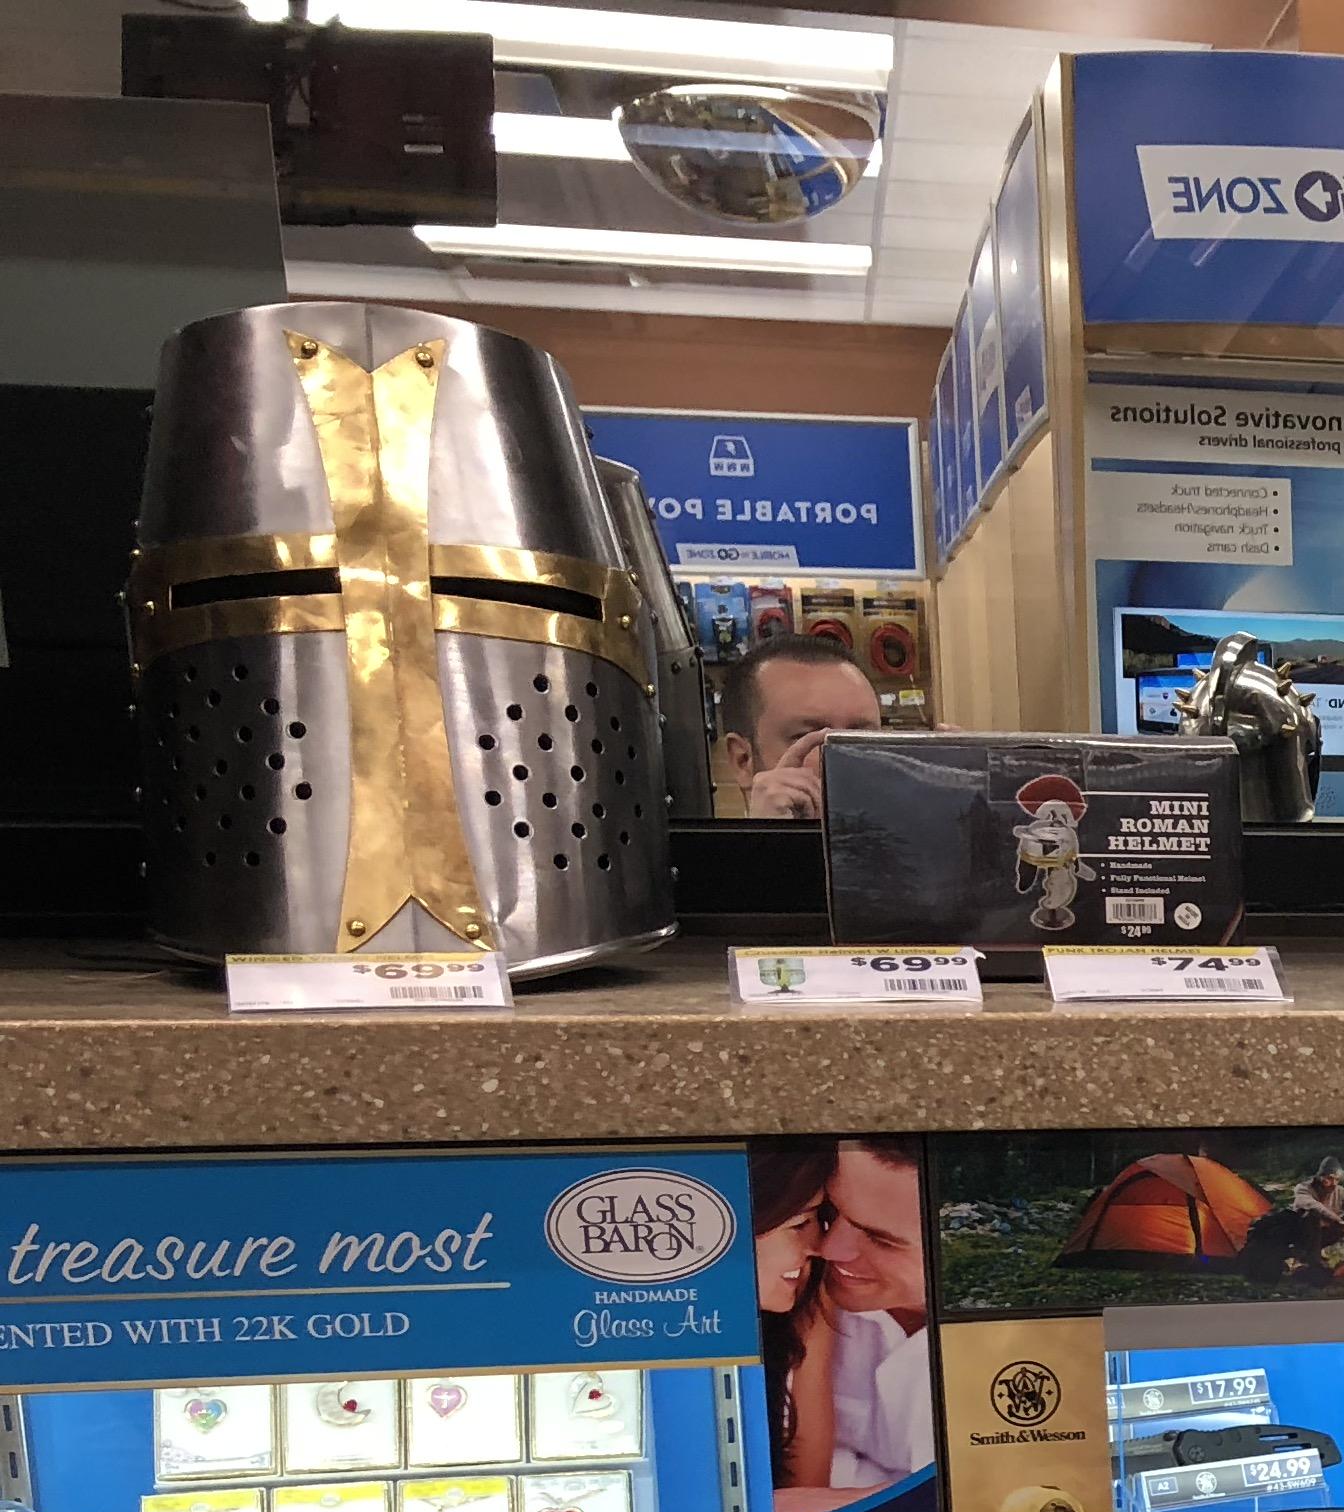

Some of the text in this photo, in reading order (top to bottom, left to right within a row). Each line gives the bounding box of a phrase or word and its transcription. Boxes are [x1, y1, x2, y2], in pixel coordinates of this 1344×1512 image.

[1150, 801, 1209, 816] MINI
[1120, 818, 1210, 833] ROMAN
[1108, 836, 1210, 851] HELMET
[575, 1194, 695, 1228] GLASS
[8, 1212, 494, 1285] treasure most
[581, 1221, 697, 1262] BARON
[594, 1288, 698, 1306] HANDMADE
[122, 1318, 224, 1345] WITH
[232, 1315, 296, 1343] 22K
[306, 1312, 410, 1339] GOLD
[573, 1304, 722, 1348] Glass Art
[1197, 1376, 1258, 1399] $17.99
[1249, 1456, 1312, 1483] $24.99
